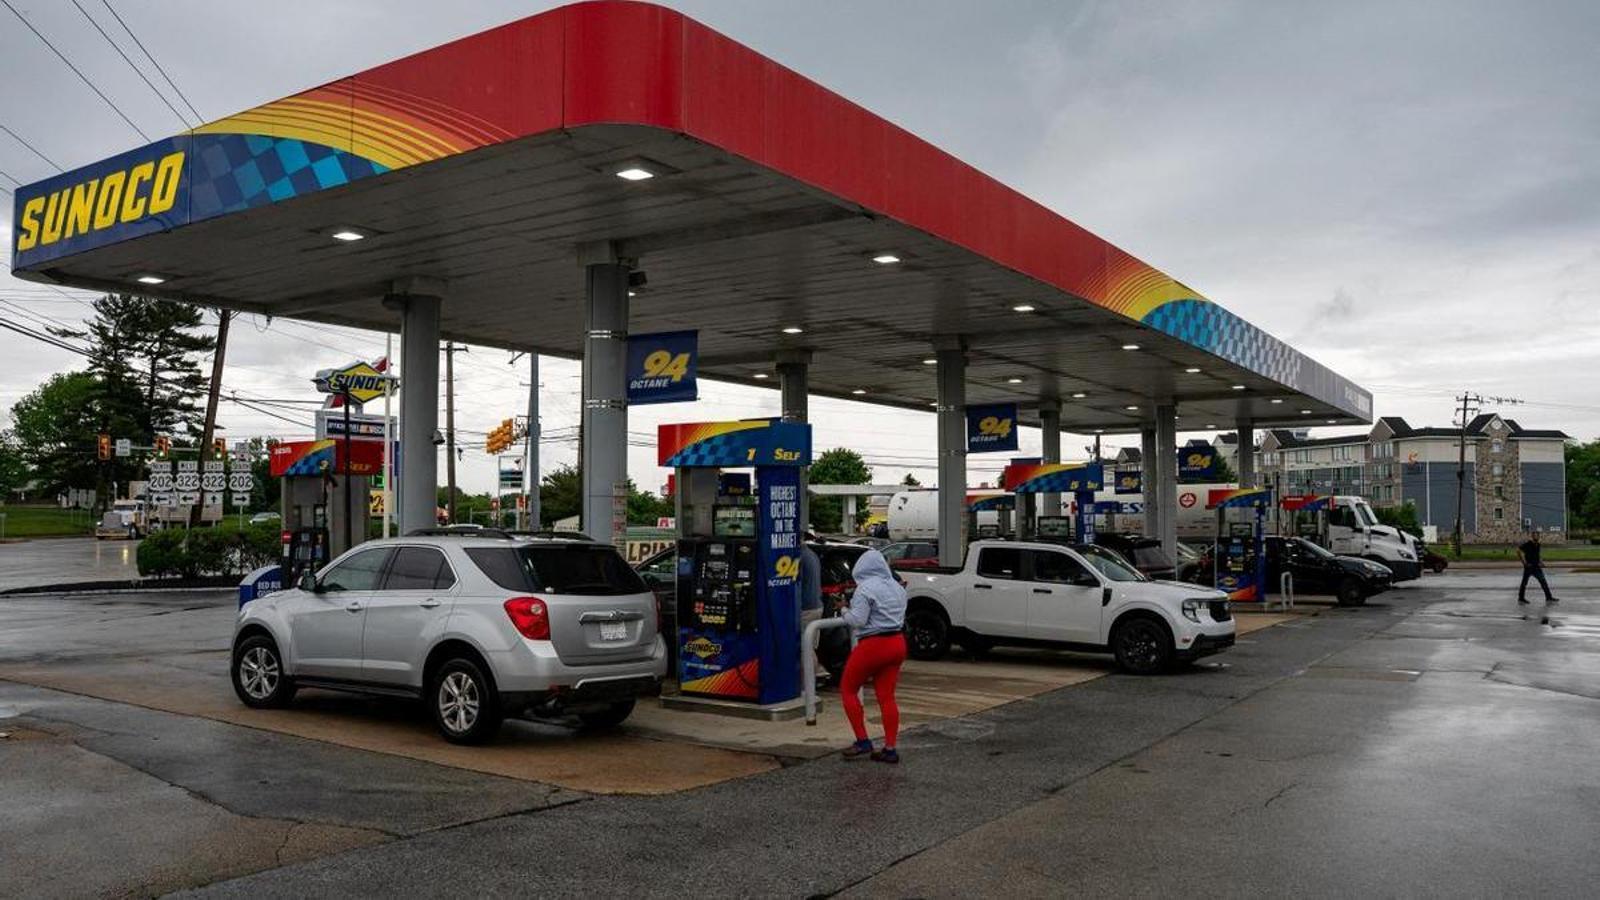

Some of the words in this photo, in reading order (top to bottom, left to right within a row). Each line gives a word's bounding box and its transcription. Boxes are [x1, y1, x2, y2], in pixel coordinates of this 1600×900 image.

[17, 150, 186, 252] SUNOCO
[643, 350, 691, 382] 94
[630, 378, 670, 389] OCTANE
[979, 416, 1012, 438] 94
[746, 448, 756, 461] 1
[774, 448, 800, 461] SELF
[1187, 453, 1212, 469] 94
[151, 476, 171, 488] 202
[177, 475, 198, 487] 322
[205, 475, 224, 488] 322
[231, 475, 251, 488] 202
[770, 486, 796, 500] HIGHEST
[770, 502, 796, 519] OCTANE
[774, 520, 784, 532] ON
[771, 533, 797, 549] MARKET
[775, 555, 800, 582] 94
[684, 642, 721, 654] SUNOCO
